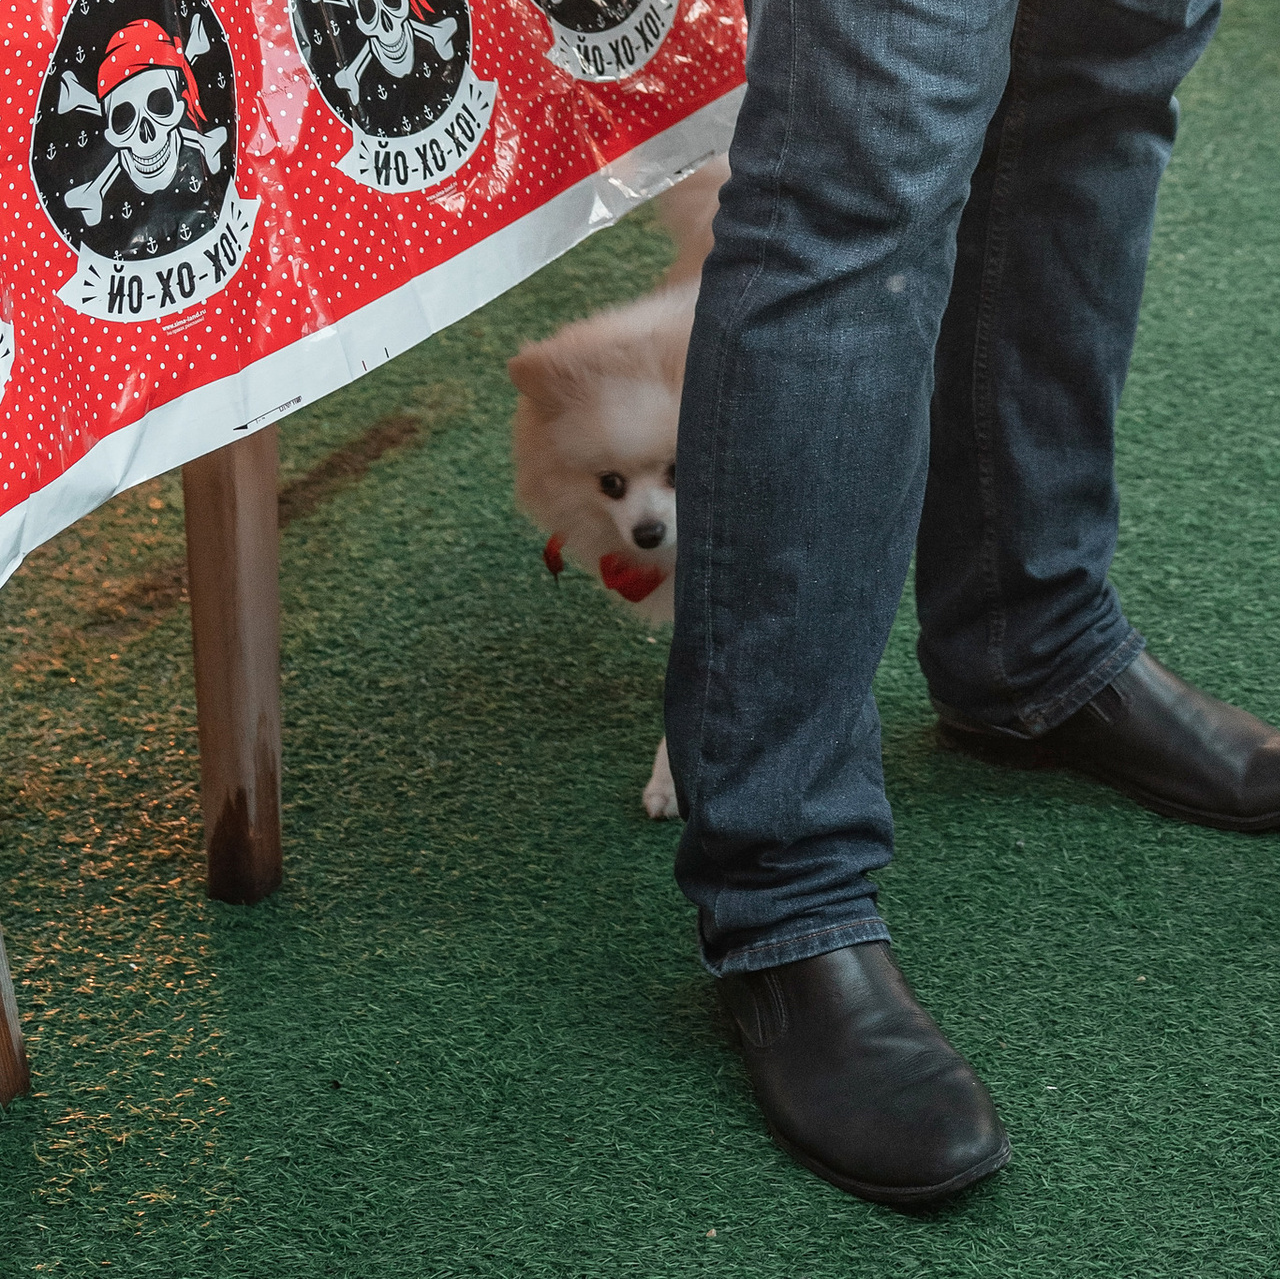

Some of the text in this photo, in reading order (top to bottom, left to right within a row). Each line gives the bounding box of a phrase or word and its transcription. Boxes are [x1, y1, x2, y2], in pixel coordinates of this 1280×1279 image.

[577, 4, 666, 76] ЙО-ХО-ХО!
[373, 102, 481, 186] ЙО-ХО-ХО!
[107, 222, 242, 315] ЙО-ХО-ХО!
